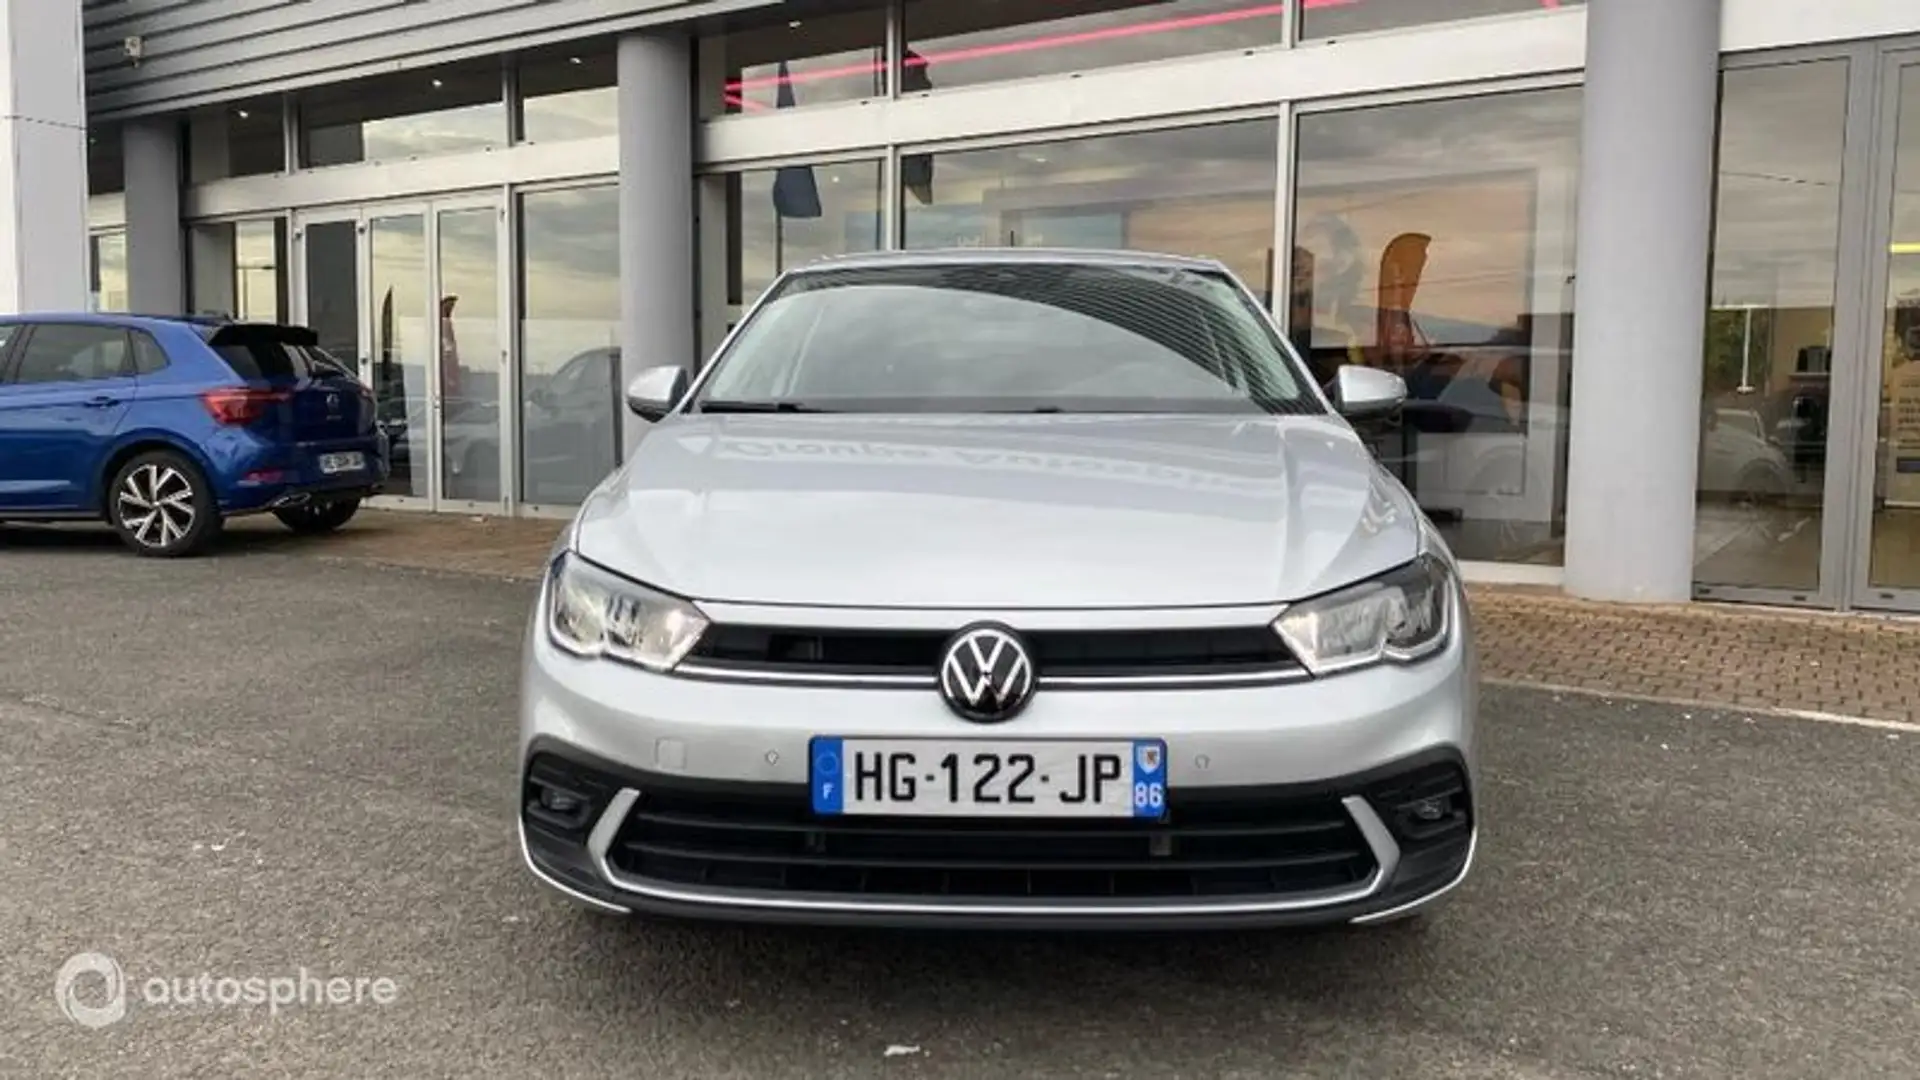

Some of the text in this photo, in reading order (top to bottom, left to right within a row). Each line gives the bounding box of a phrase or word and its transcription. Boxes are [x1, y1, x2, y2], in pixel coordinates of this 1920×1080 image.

[943, 629, 1031, 708] VW
[823, 783, 834, 799] F
[1135, 781, 1163, 807] 86
